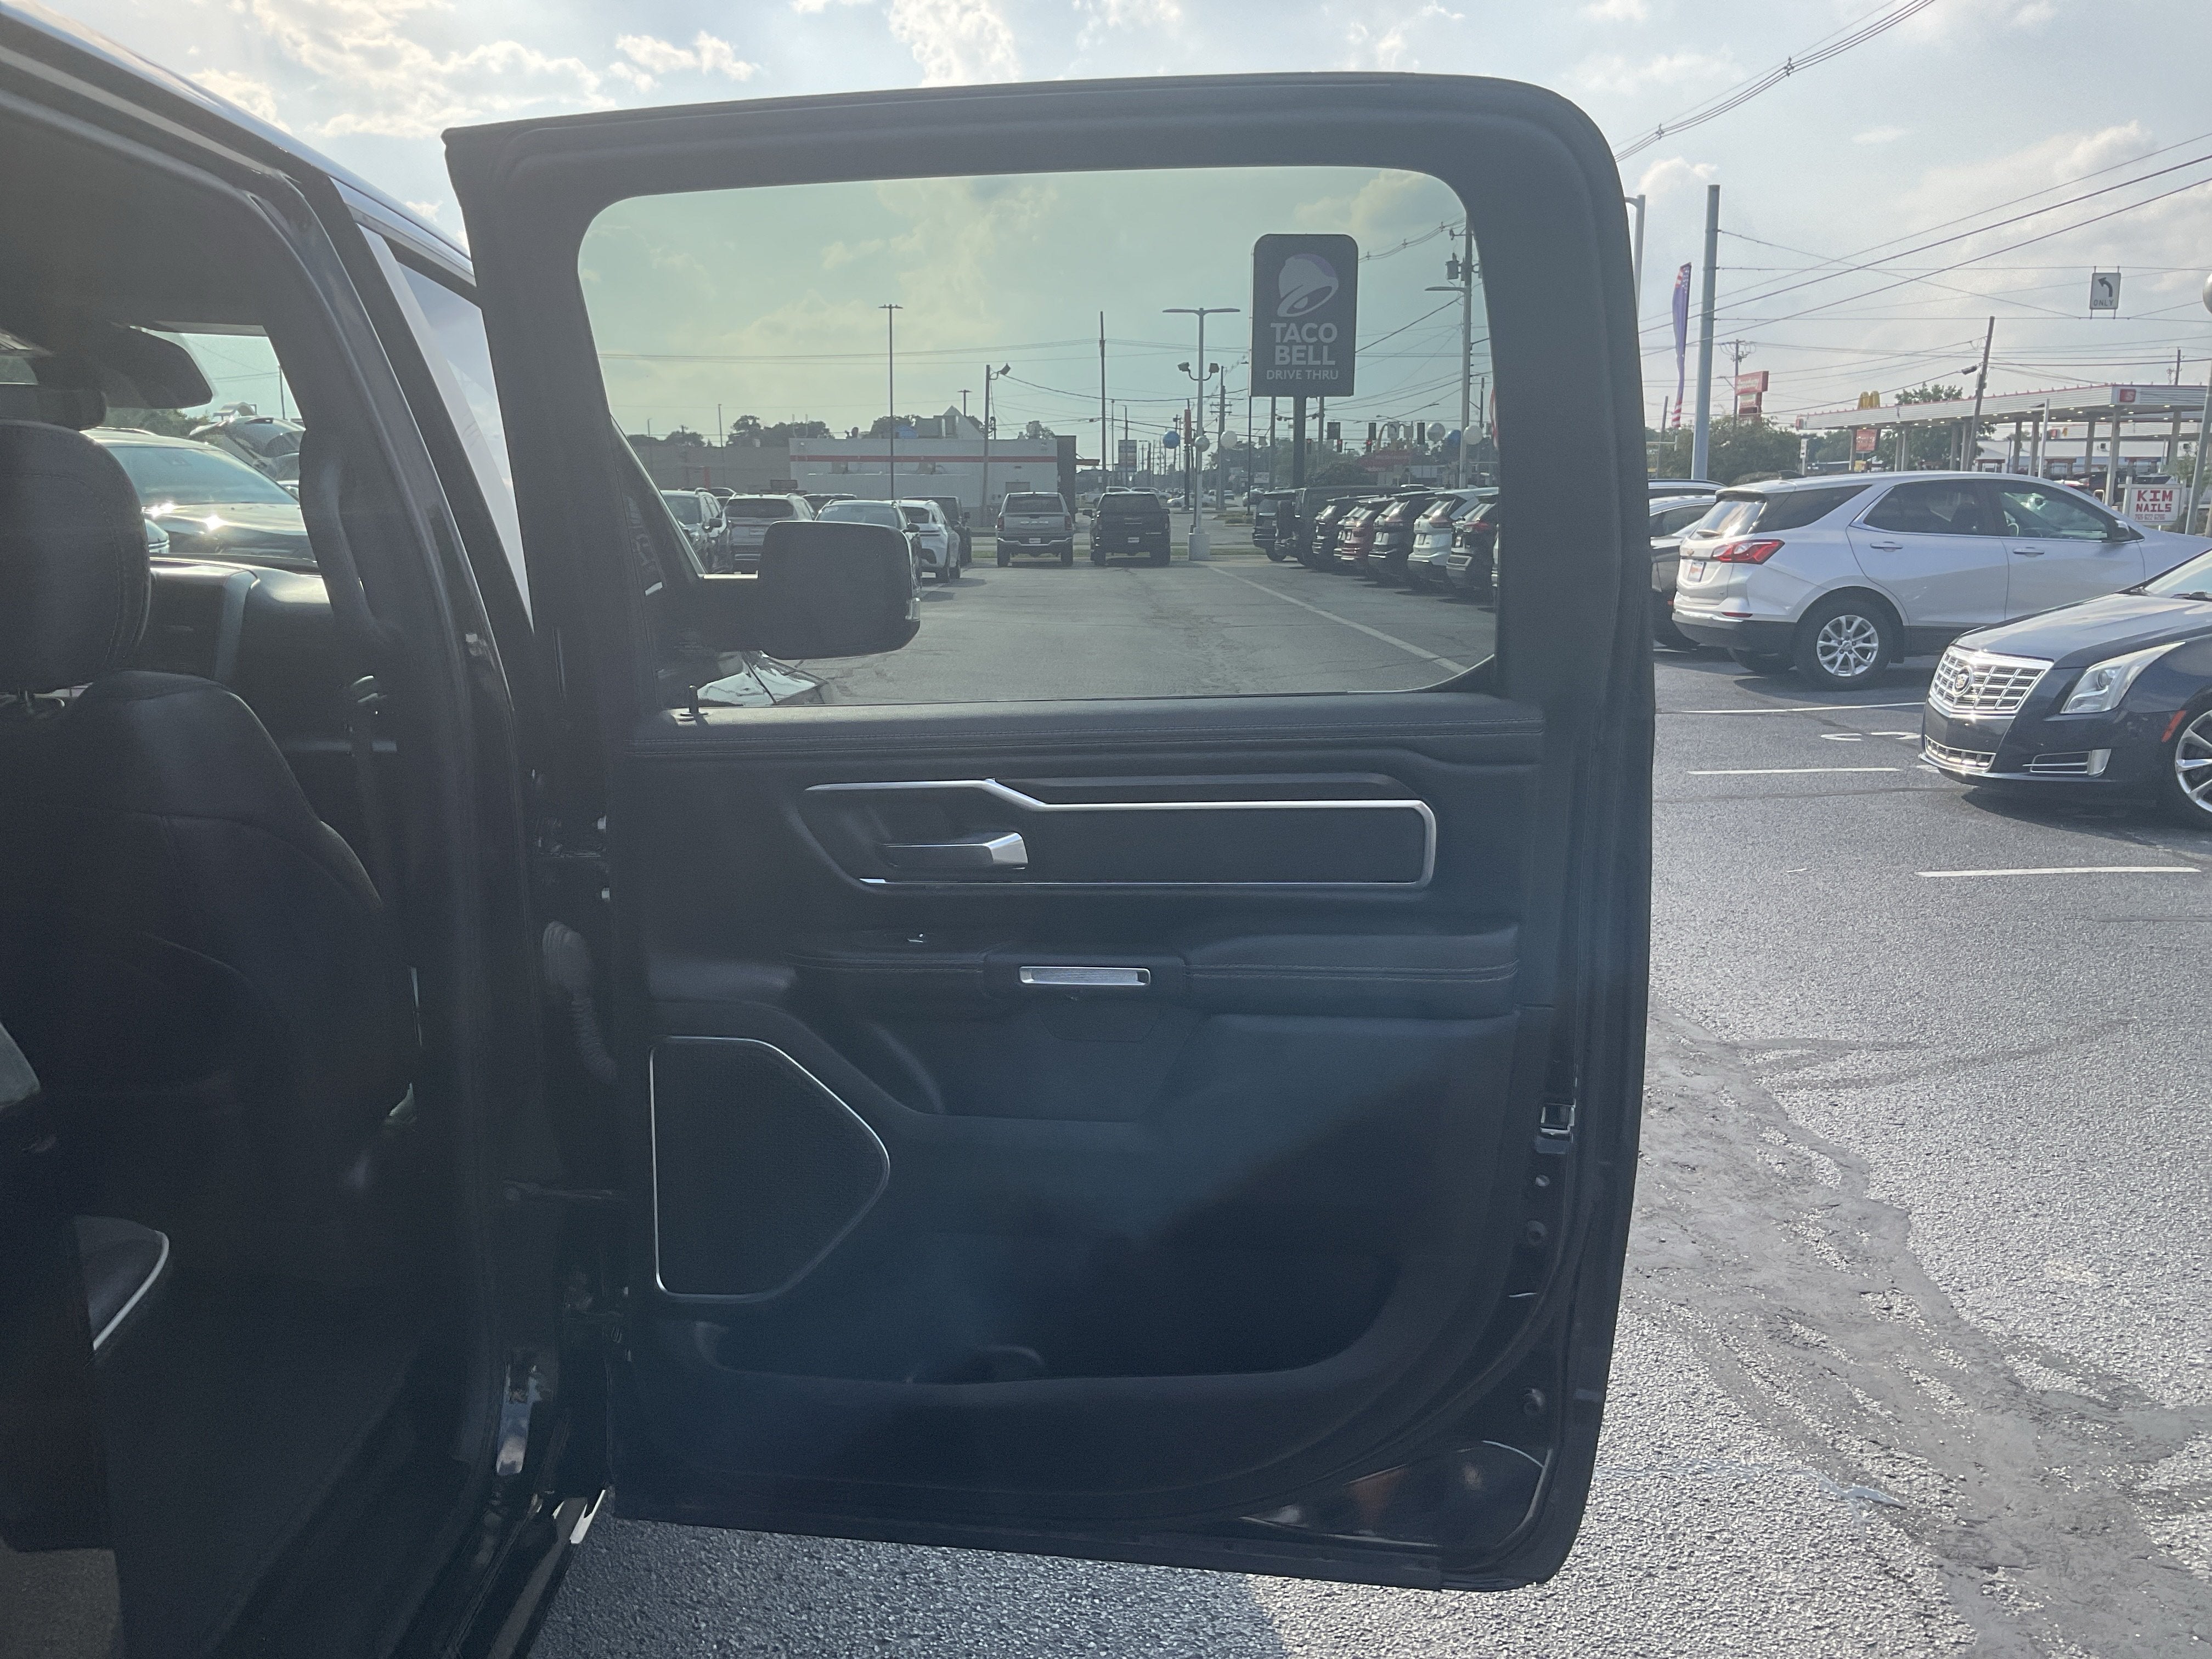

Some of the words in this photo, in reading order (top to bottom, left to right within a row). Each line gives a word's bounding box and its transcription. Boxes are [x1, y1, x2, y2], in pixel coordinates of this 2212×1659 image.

[1271, 323, 1338, 343] TACO
[1275, 345, 1335, 365] BELL
[1266, 370, 1302, 380] DRIVE
[1305, 370, 1338, 380] THRU
[2137, 490, 2173, 501] KIM
[2136, 503, 2171, 512] NAILS
